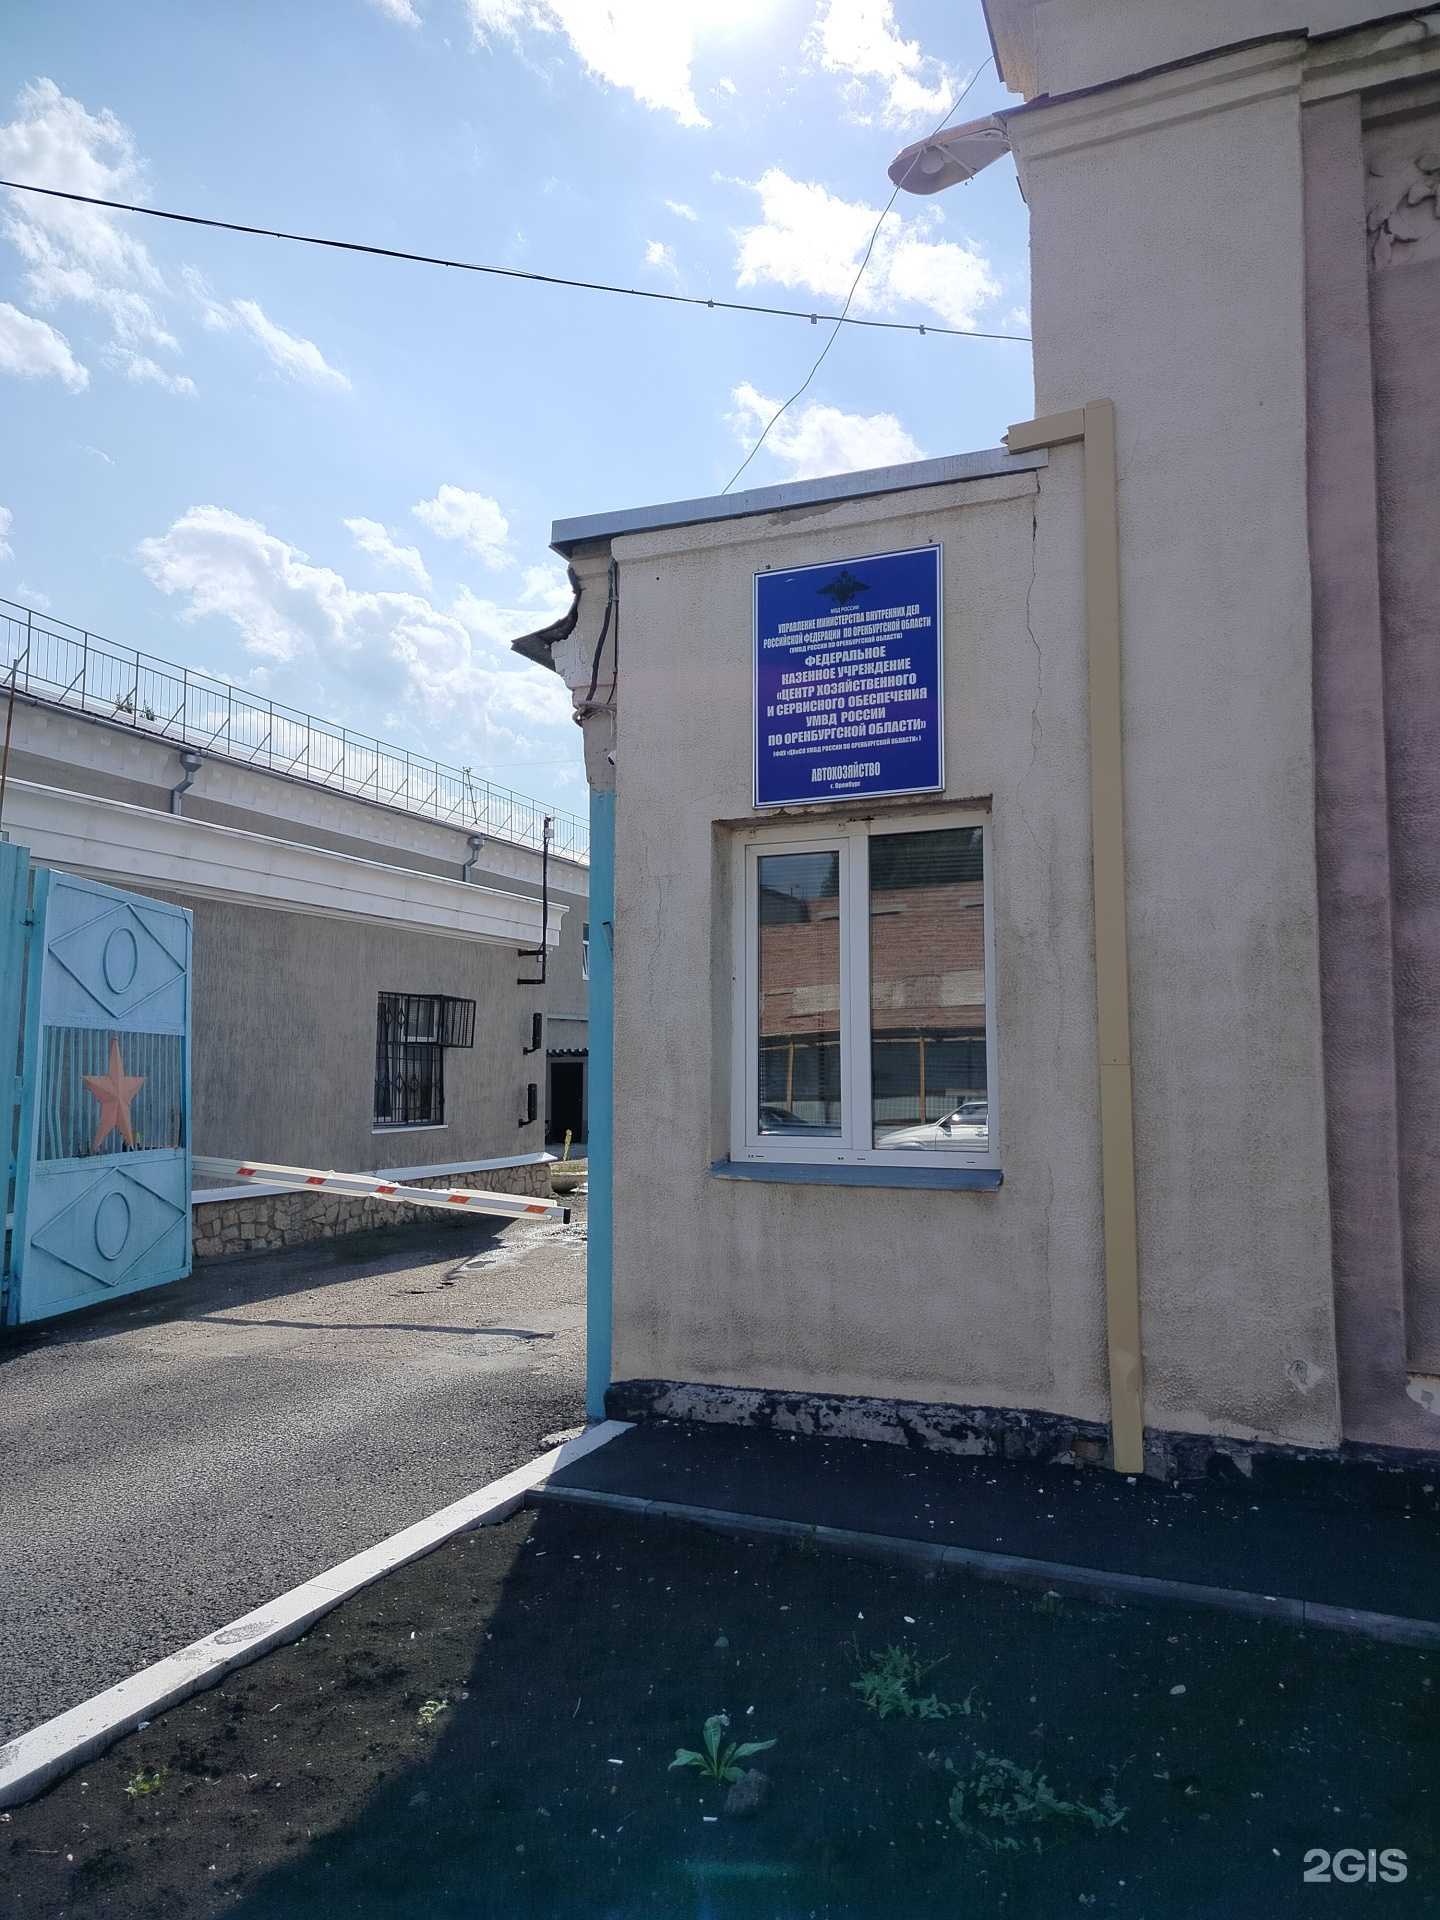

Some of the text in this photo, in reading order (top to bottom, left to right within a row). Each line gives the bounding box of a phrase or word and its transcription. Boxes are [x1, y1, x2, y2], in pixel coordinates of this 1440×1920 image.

[764, 616, 932, 648] РОССИЙСКОЙ ФЕДЕРАЦИИ ПО ОРЕНБУРГСКОЙ ОБЛАСТИ
[778, 604, 920, 633] УПРАВЛЕНИЕ МИНИСТЕРСТВА ВНУТРЕННИХ ДЕЛ
[805, 646, 886, 666] ФЕДЕРАЛЬНОЕ
[807, 642, 827, 651] РОССИИ
[836, 636, 875, 647] ОРЕНБУРГСКОЙ
[782, 658, 911, 685] КАЗЕННОЕ УЧРЕЖДЕНИЕ
[777, 673, 916, 701] «ЦЕНТР ХОЗЯЙСТВЕННОГО
[768, 688, 928, 717] И СЕРВИСНОГО ОБЕСПЕЧЕНИЯ
[806, 707, 886, 727] УМВД РОССИИ
[768, 718, 926, 746] ПО ОРЕНБУРГСКОЙ ОБЛАСТИ»
[822, 744, 842, 752] РОССИИ
[851, 738, 890, 748] ОРЕНБУРГСКОЙ
[812, 761, 880, 782] АВТОХОЗЯЙСТВО
